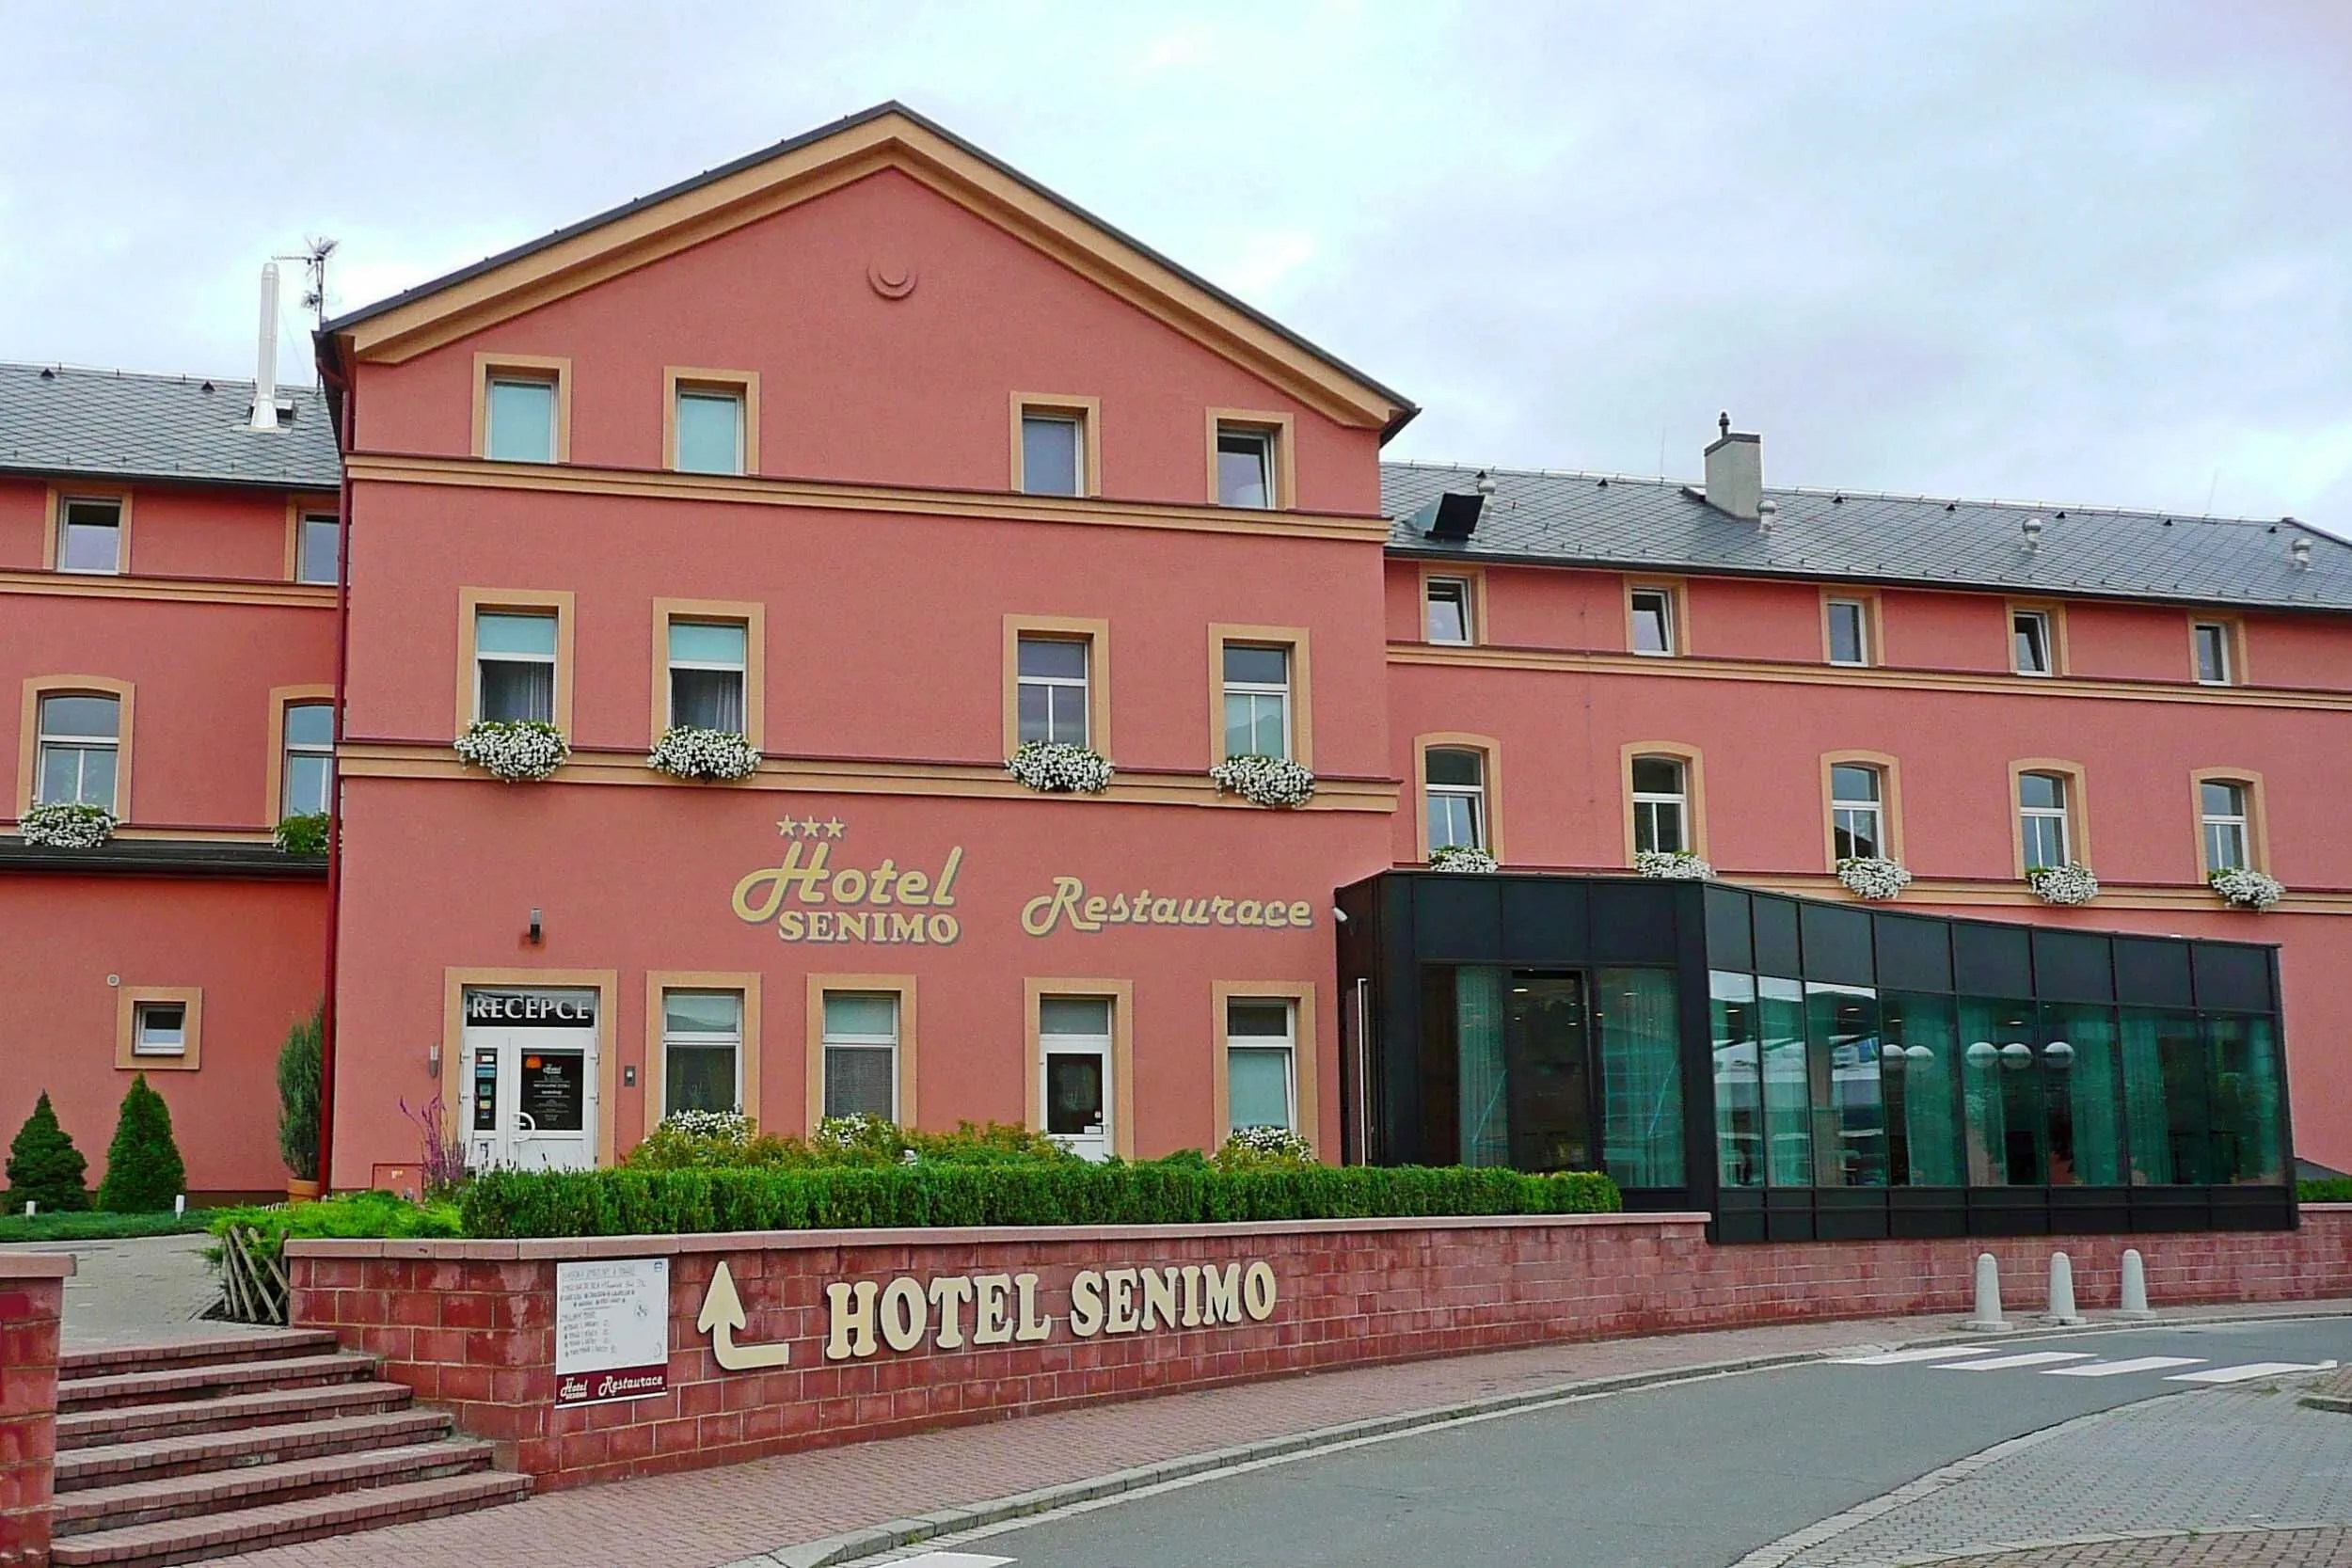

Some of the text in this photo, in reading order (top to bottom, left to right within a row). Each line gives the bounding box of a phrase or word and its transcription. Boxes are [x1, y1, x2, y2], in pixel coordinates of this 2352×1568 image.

[731, 841, 963, 923] Hotel
[778, 910, 961, 944] SENIMO
[1021, 876, 1314, 938] Restaurace
[472, 995, 589, 1019] RECEPCE
[825, 1259, 1279, 1361] HOTEL SENIMO
[598, 1375, 662, 1396] Restaurace
